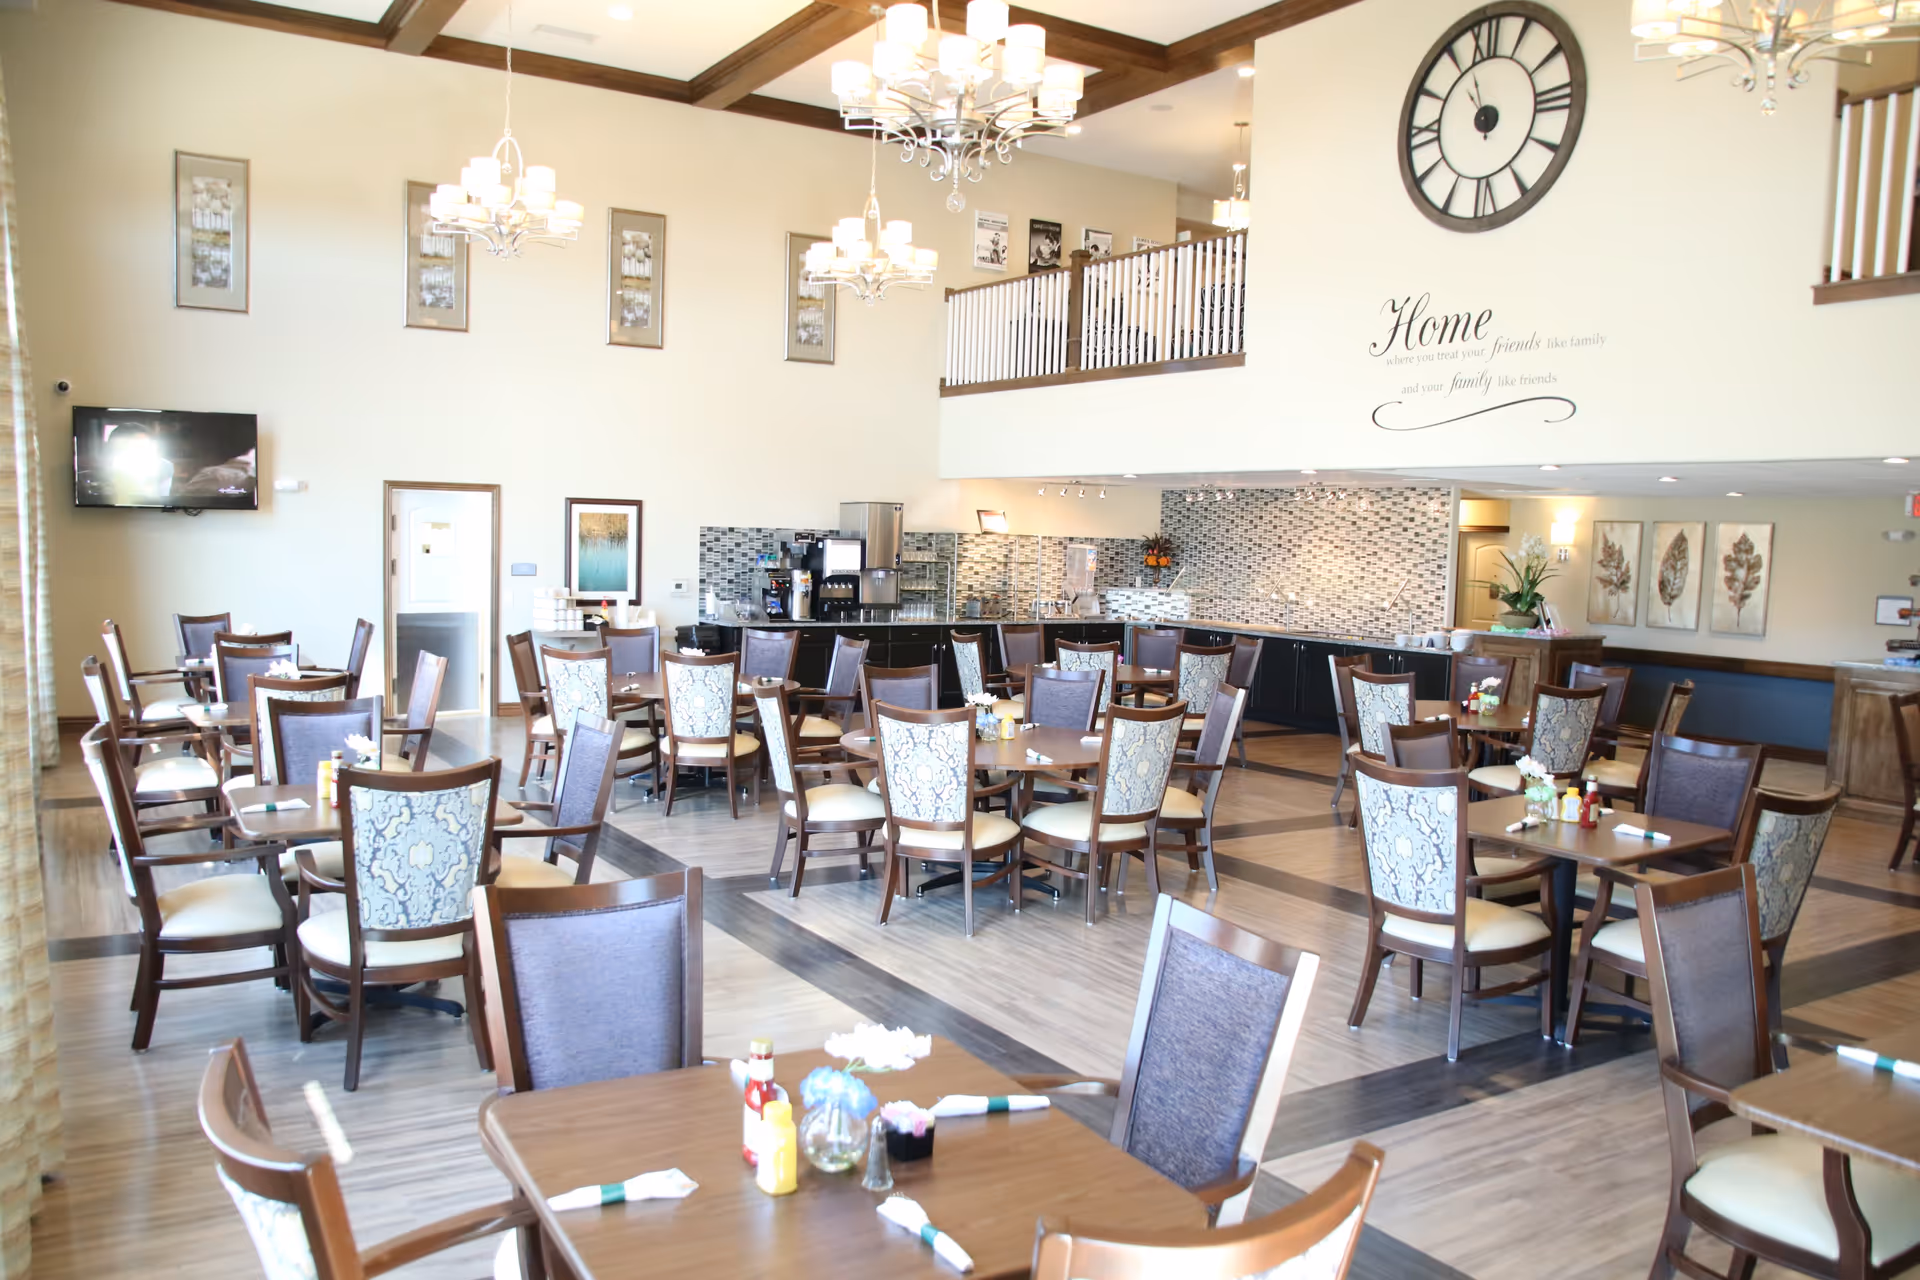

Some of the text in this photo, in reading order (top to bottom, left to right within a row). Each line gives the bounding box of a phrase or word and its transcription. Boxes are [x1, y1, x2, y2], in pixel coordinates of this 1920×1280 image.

[1369, 292, 1492, 357] Home
[1386, 331, 1607, 366] where you treat your friends like family
[1401, 368, 1557, 398] and your family like friends
